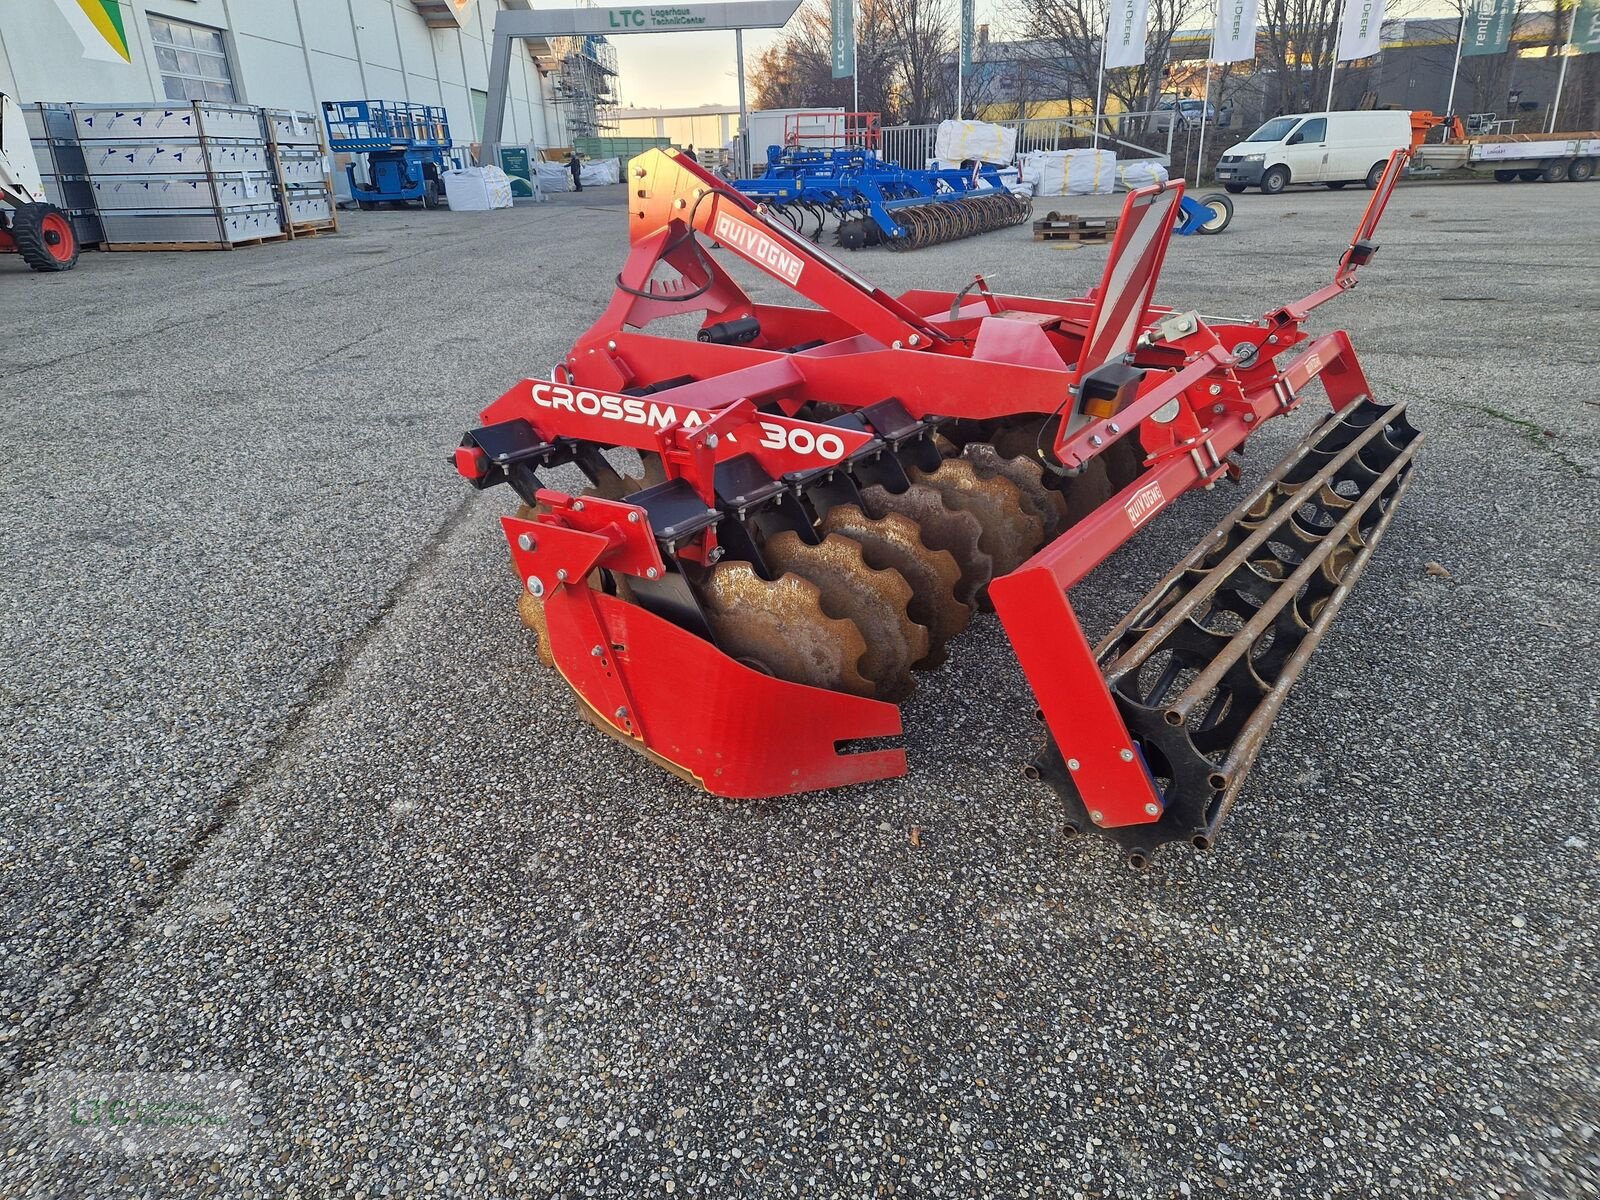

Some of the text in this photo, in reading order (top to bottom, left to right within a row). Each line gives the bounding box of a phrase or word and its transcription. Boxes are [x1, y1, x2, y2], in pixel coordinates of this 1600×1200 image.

[608, 9, 645, 28] LTC
[1123, 10, 1134, 47] DEERE
[1231, 6, 1243, 41] DEERE
[1359, 3, 1372, 39] DEERE
[718, 216, 799, 278] QUIVOGNE
[759, 421, 845, 460] 300
[1127, 486, 1162, 522] QUIVOGNE
